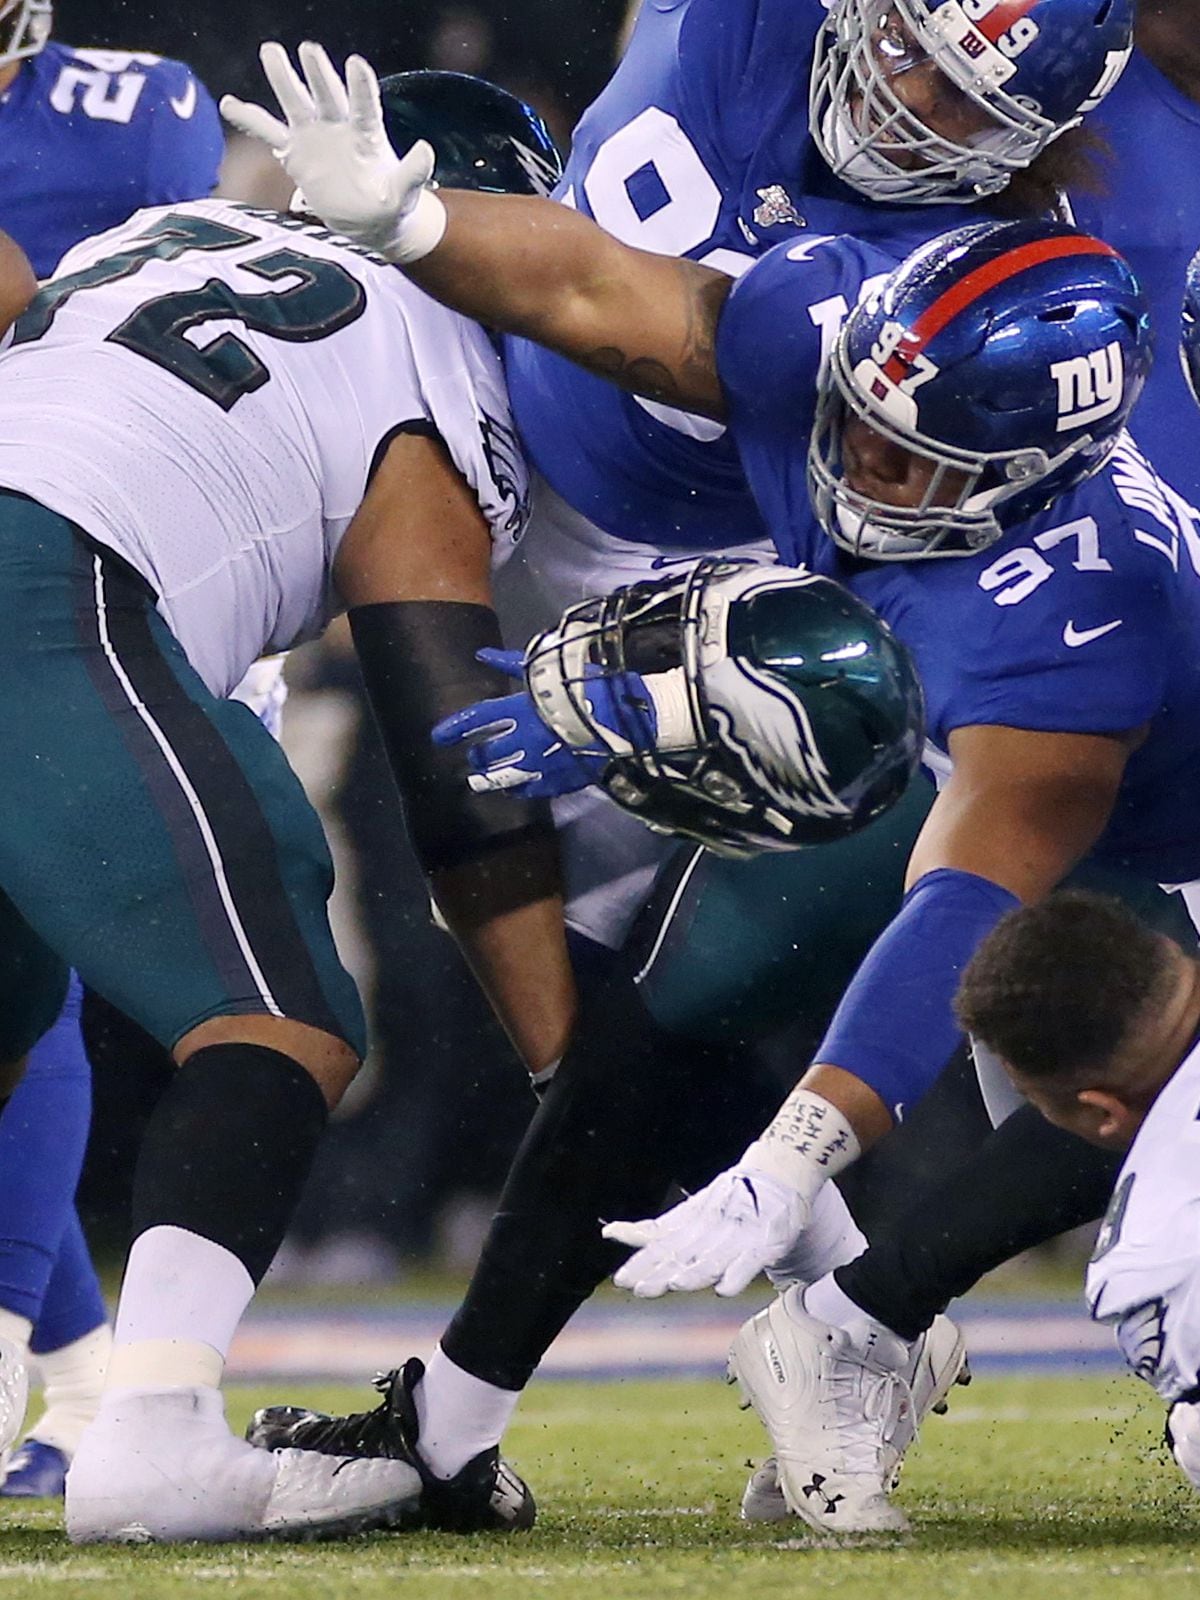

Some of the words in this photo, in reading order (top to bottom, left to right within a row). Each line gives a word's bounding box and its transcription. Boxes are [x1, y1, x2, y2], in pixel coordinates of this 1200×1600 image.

[8, 212, 367, 413] 72
[870, 320, 940, 397] 97
[977, 515, 1113, 607] 97
